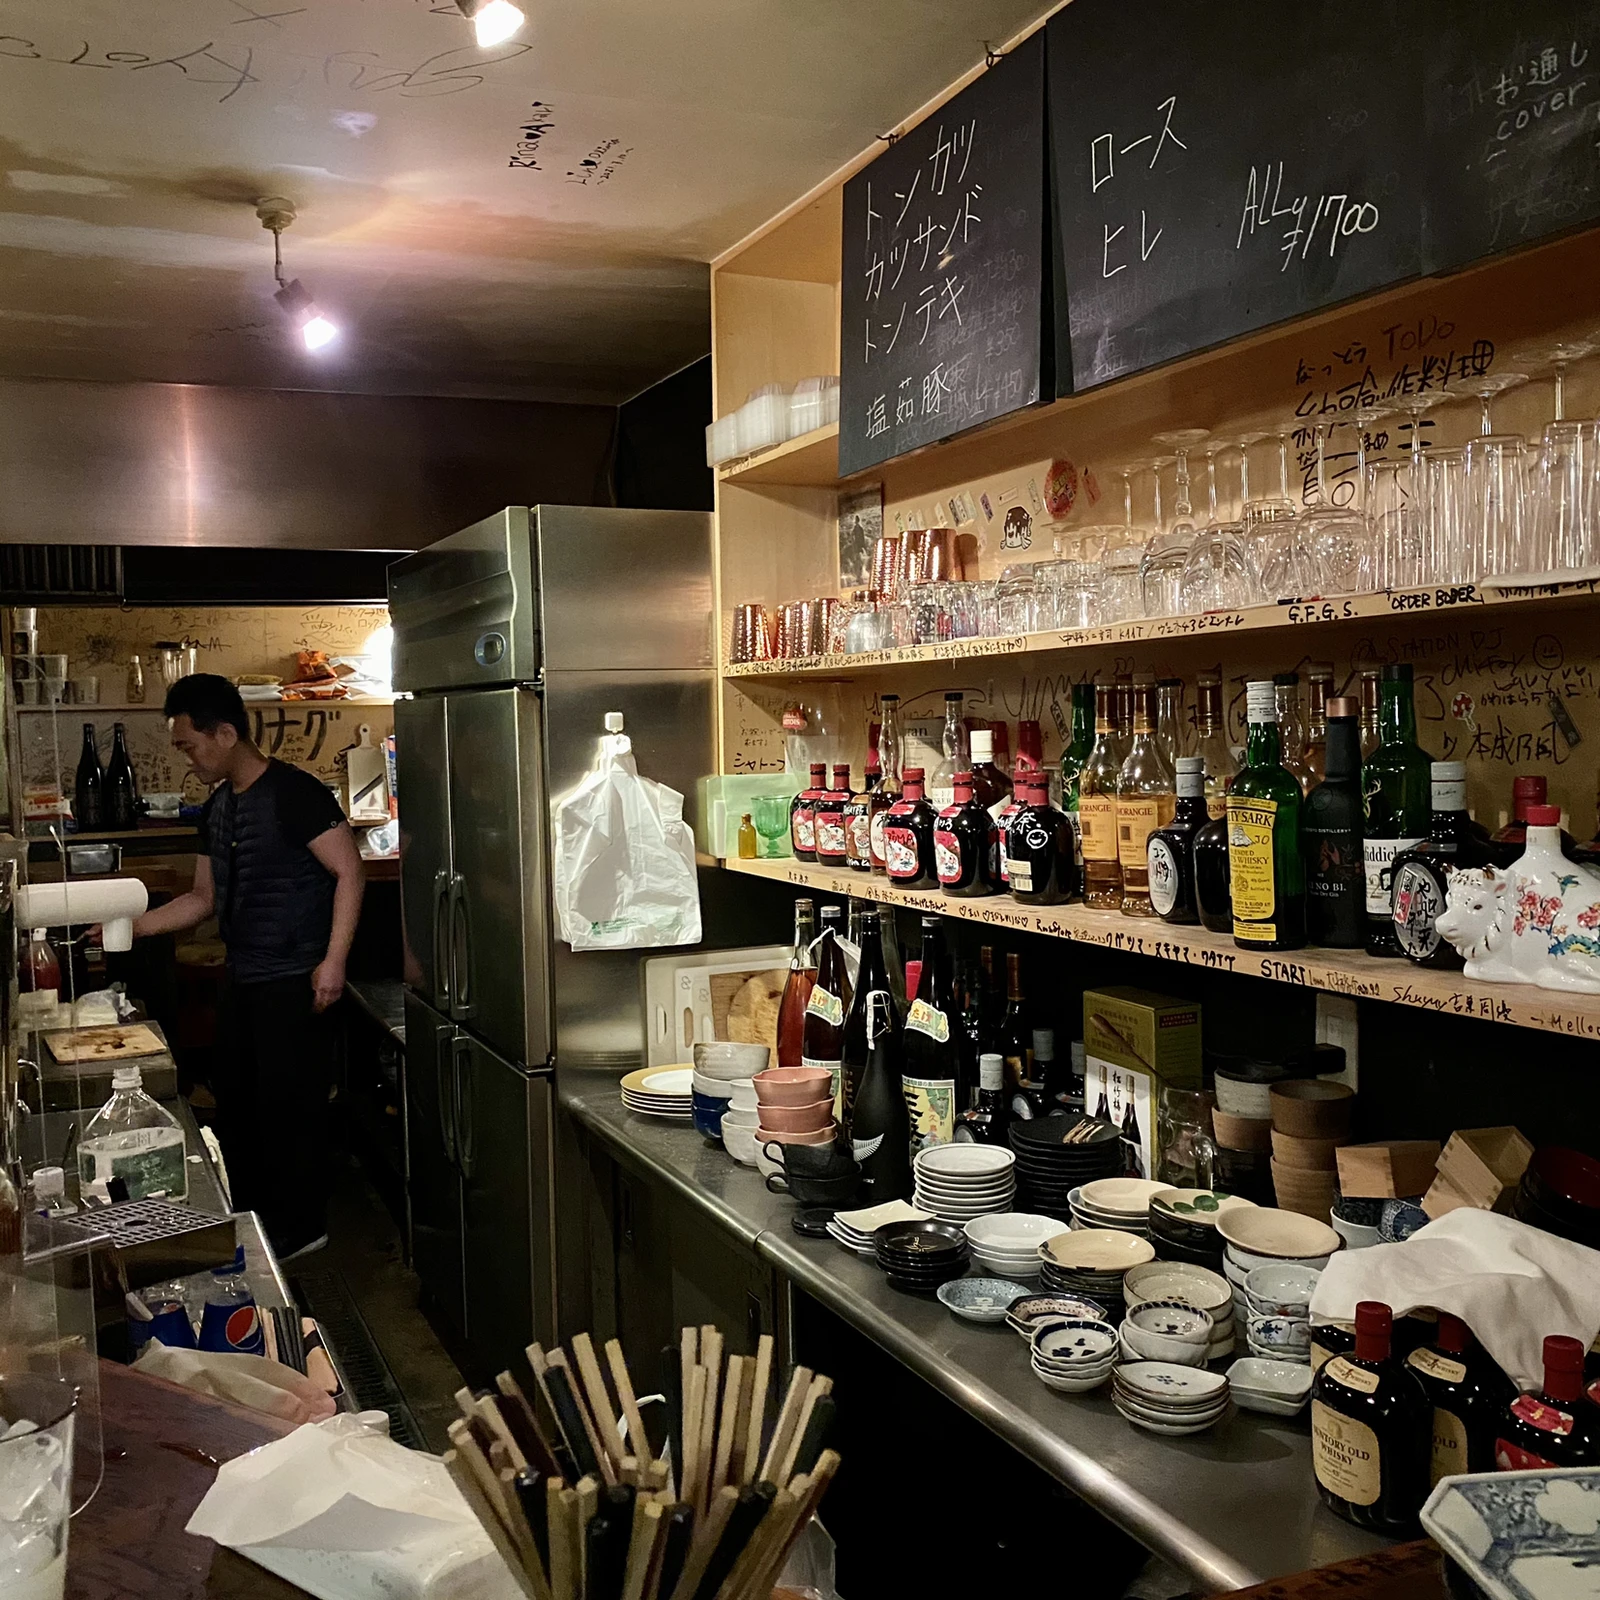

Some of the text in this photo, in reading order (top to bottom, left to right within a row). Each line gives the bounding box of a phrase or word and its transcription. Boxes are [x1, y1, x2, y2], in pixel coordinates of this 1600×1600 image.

[1091, 96, 1188, 193] ロース
[866, 119, 976, 241] トンカツ
[865, 183, 984, 301] カツサンド
[1103, 210, 1163, 278] ヒレ
[1241, 811, 1273, 828] SARK
[1237, 856, 1270, 866] WHISKY
[1260, 958, 1306, 986] START
[1320, 1441, 1354, 1466] WHISKY
[1347, 1445, 1371, 1462] OLD
